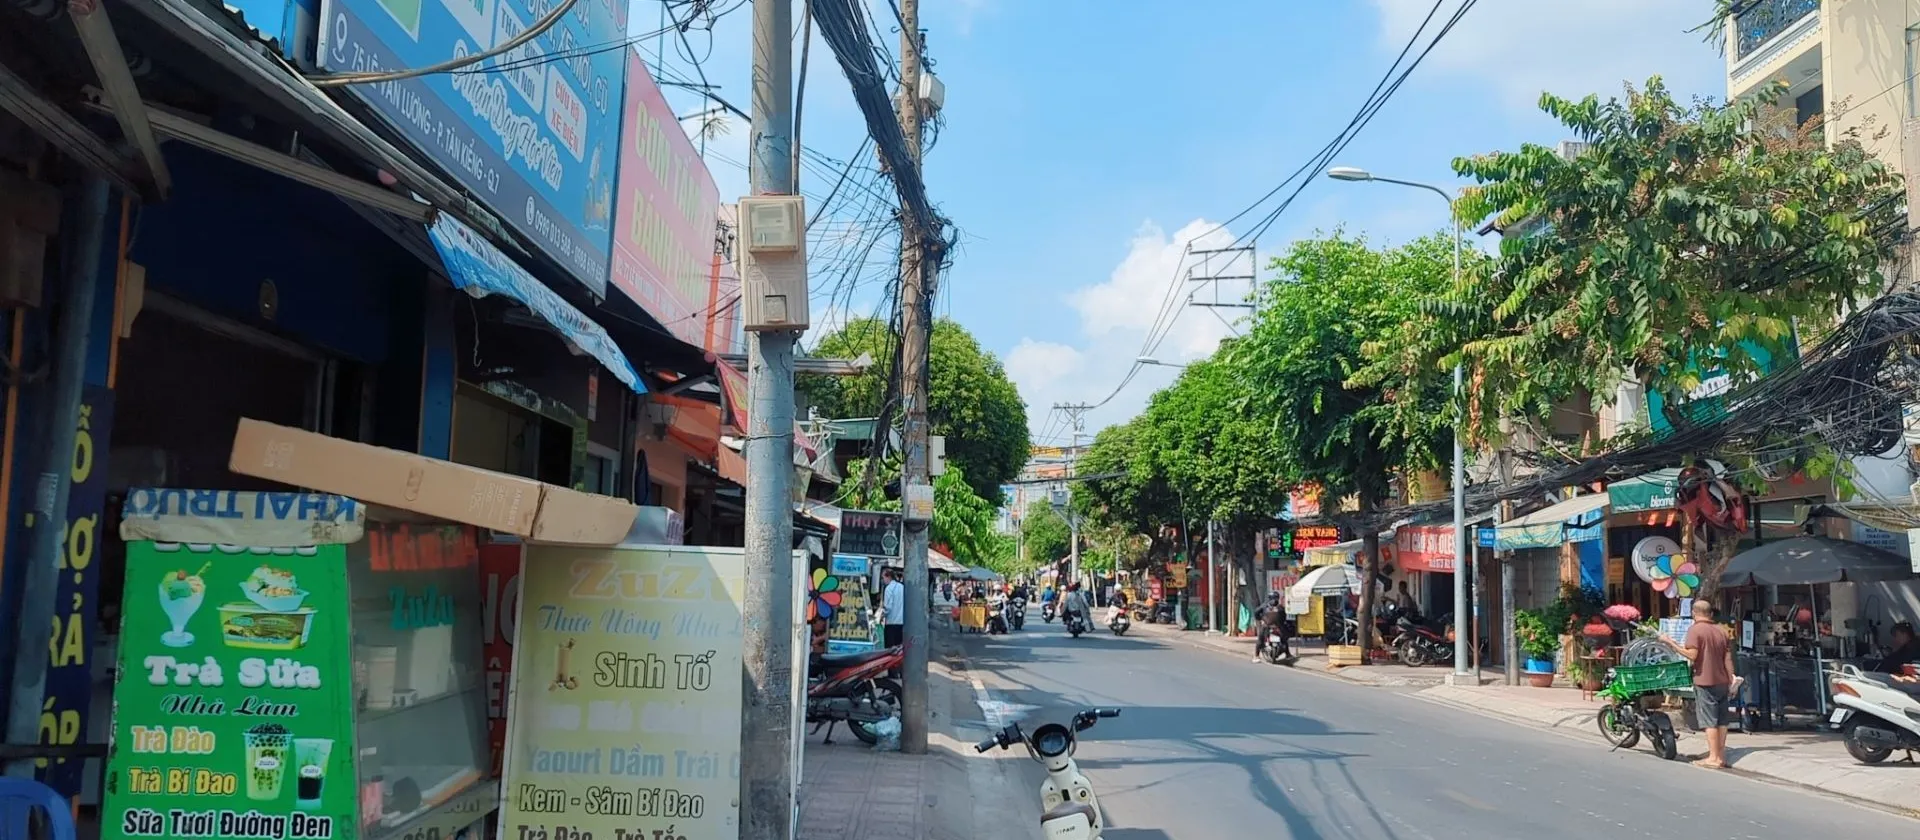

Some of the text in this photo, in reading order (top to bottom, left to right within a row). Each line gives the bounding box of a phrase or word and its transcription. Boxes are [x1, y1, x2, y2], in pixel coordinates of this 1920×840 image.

[350, 42, 364, 72] 75
[401, 90, 432, 134] LƯƠNG
[446, 126, 460, 162] TÂN
[488, 168, 500, 194] Q.7
[552, 108, 561, 133] XE
[636, 101, 670, 193] CƠM
[550, 223, 560, 248] 013
[631, 187, 674, 278] BÁNH
[71, 404, 93, 483] Ỗ
[255, 493, 356, 521] KHAI
[843, 515, 880, 530] THỤY
[569, 558, 743, 600] ZuZu
[143, 655, 321, 690] Trà Sữa
[594, 650, 716, 691] Sinh Tố
[160, 694, 299, 718] Nhà Làm
[131, 724, 215, 754] Trà Đào
[526, 746, 600, 775] Yaourt
[609, 744, 664, 777] Dầm
[674, 749, 720, 779] Trái
[128, 767, 238, 797] Trà Bí Đao
[519, 784, 566, 813] Kem
[585, 785, 632, 815] Sâm
[636, 788, 661, 817] Bí
[663, 789, 704, 818] Đao
[124, 810, 331, 840] Sữa Tươi Đường Đen
